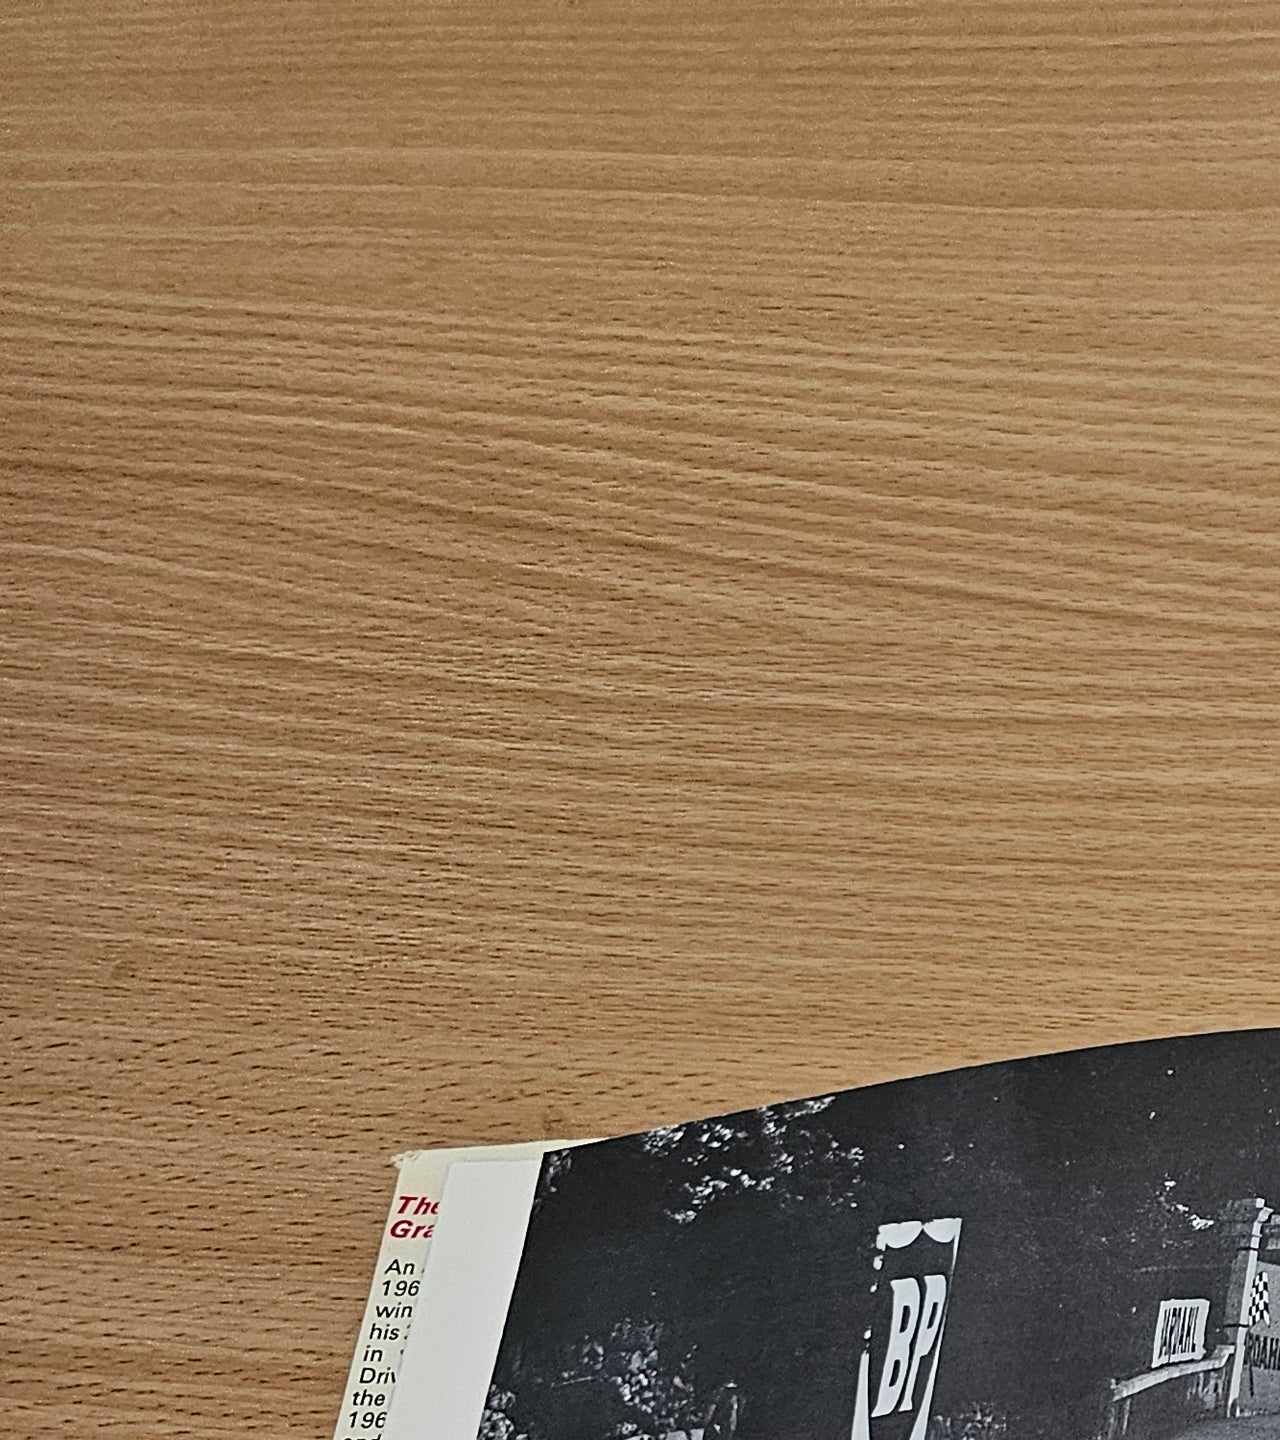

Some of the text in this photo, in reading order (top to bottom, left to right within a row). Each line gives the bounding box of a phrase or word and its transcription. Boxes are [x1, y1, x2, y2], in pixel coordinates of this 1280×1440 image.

[384, 1259, 416, 1275] An
[382, 1280, 420, 1297] 196
[375, 1302, 413, 1318] win
[369, 1323, 400, 1341] his
[363, 1346, 383, 1362] in
[871, 1274, 947, 1418] BP
[352, 1389, 386, 1407] the
